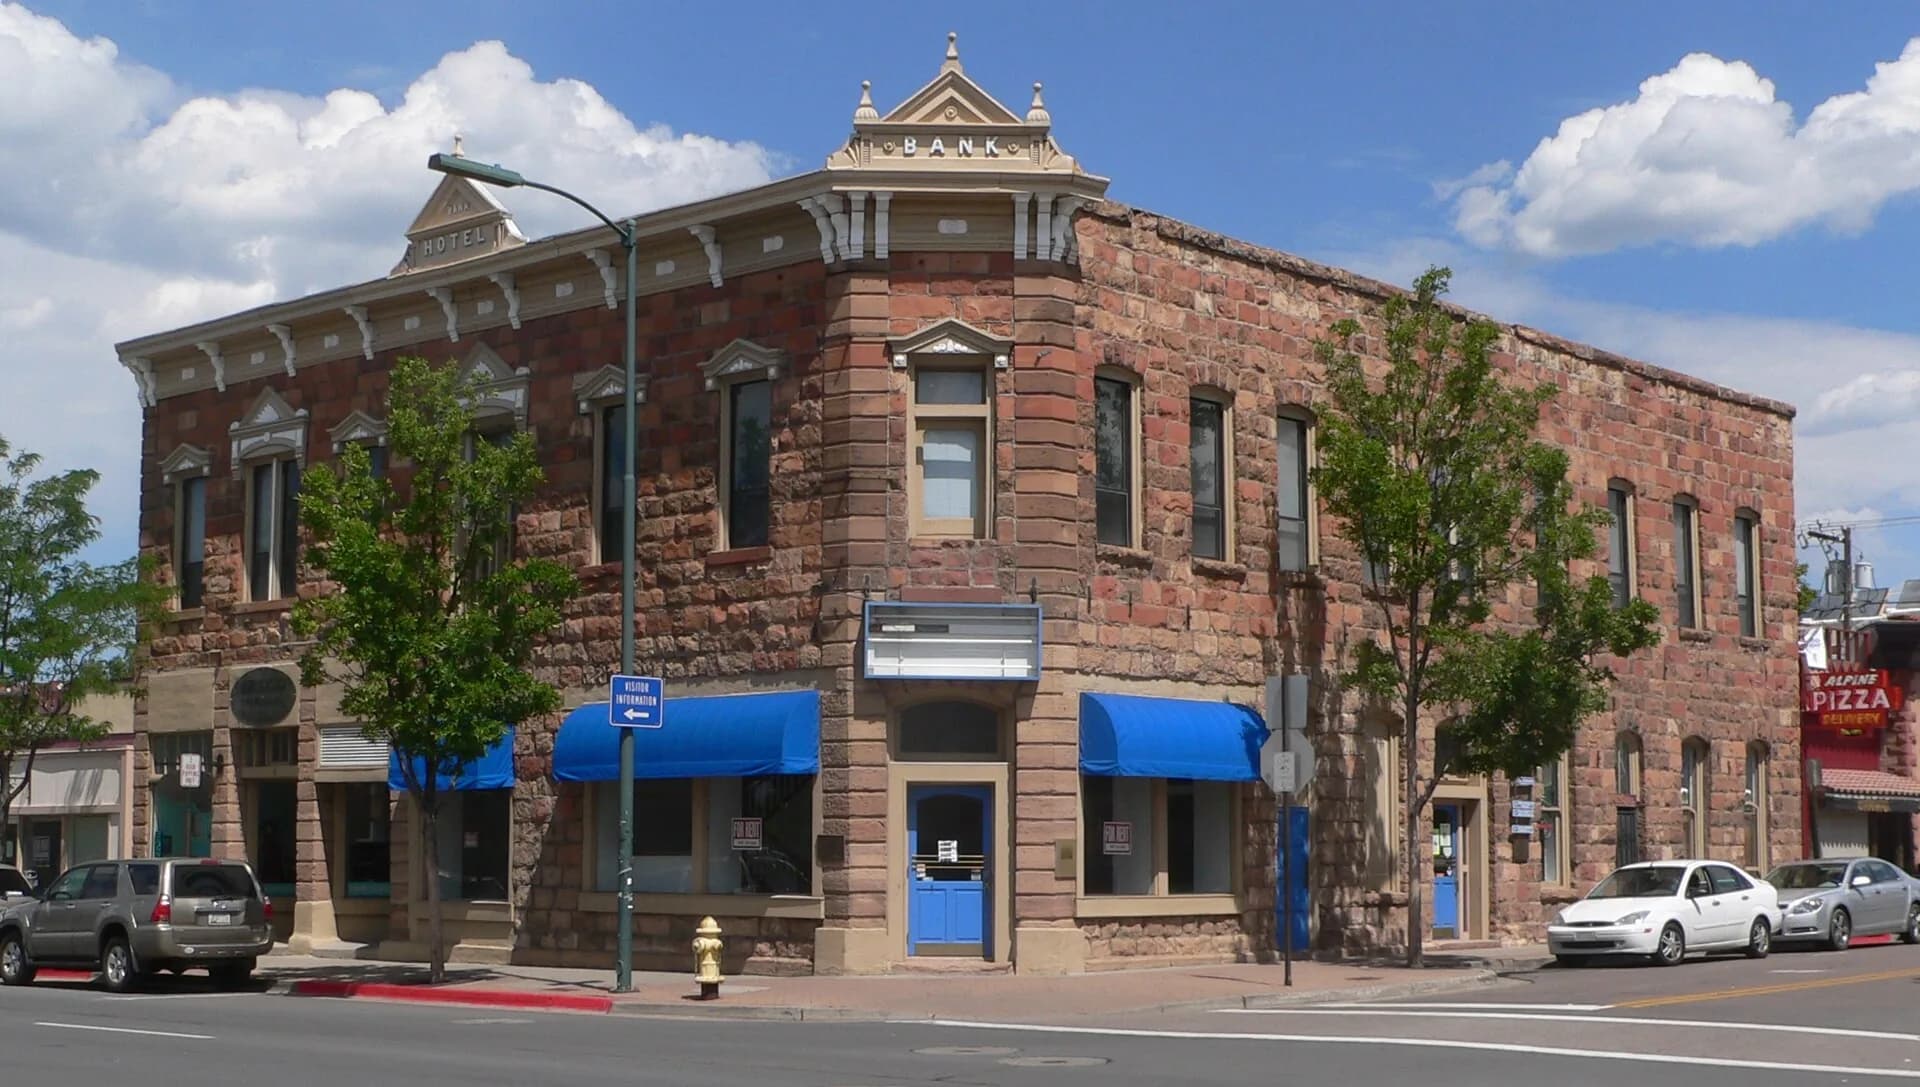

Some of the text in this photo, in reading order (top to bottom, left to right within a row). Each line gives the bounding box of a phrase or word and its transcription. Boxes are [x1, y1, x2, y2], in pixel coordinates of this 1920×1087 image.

[904, 136, 999, 154] BANK
[424, 227, 485, 257] HOTEL
[625, 681, 649, 692] VISITOR
[1824, 674, 1879, 687] ALPINE
[616, 694, 656, 706] INFORMATION
[1813, 688, 1890, 711] PIZZA
